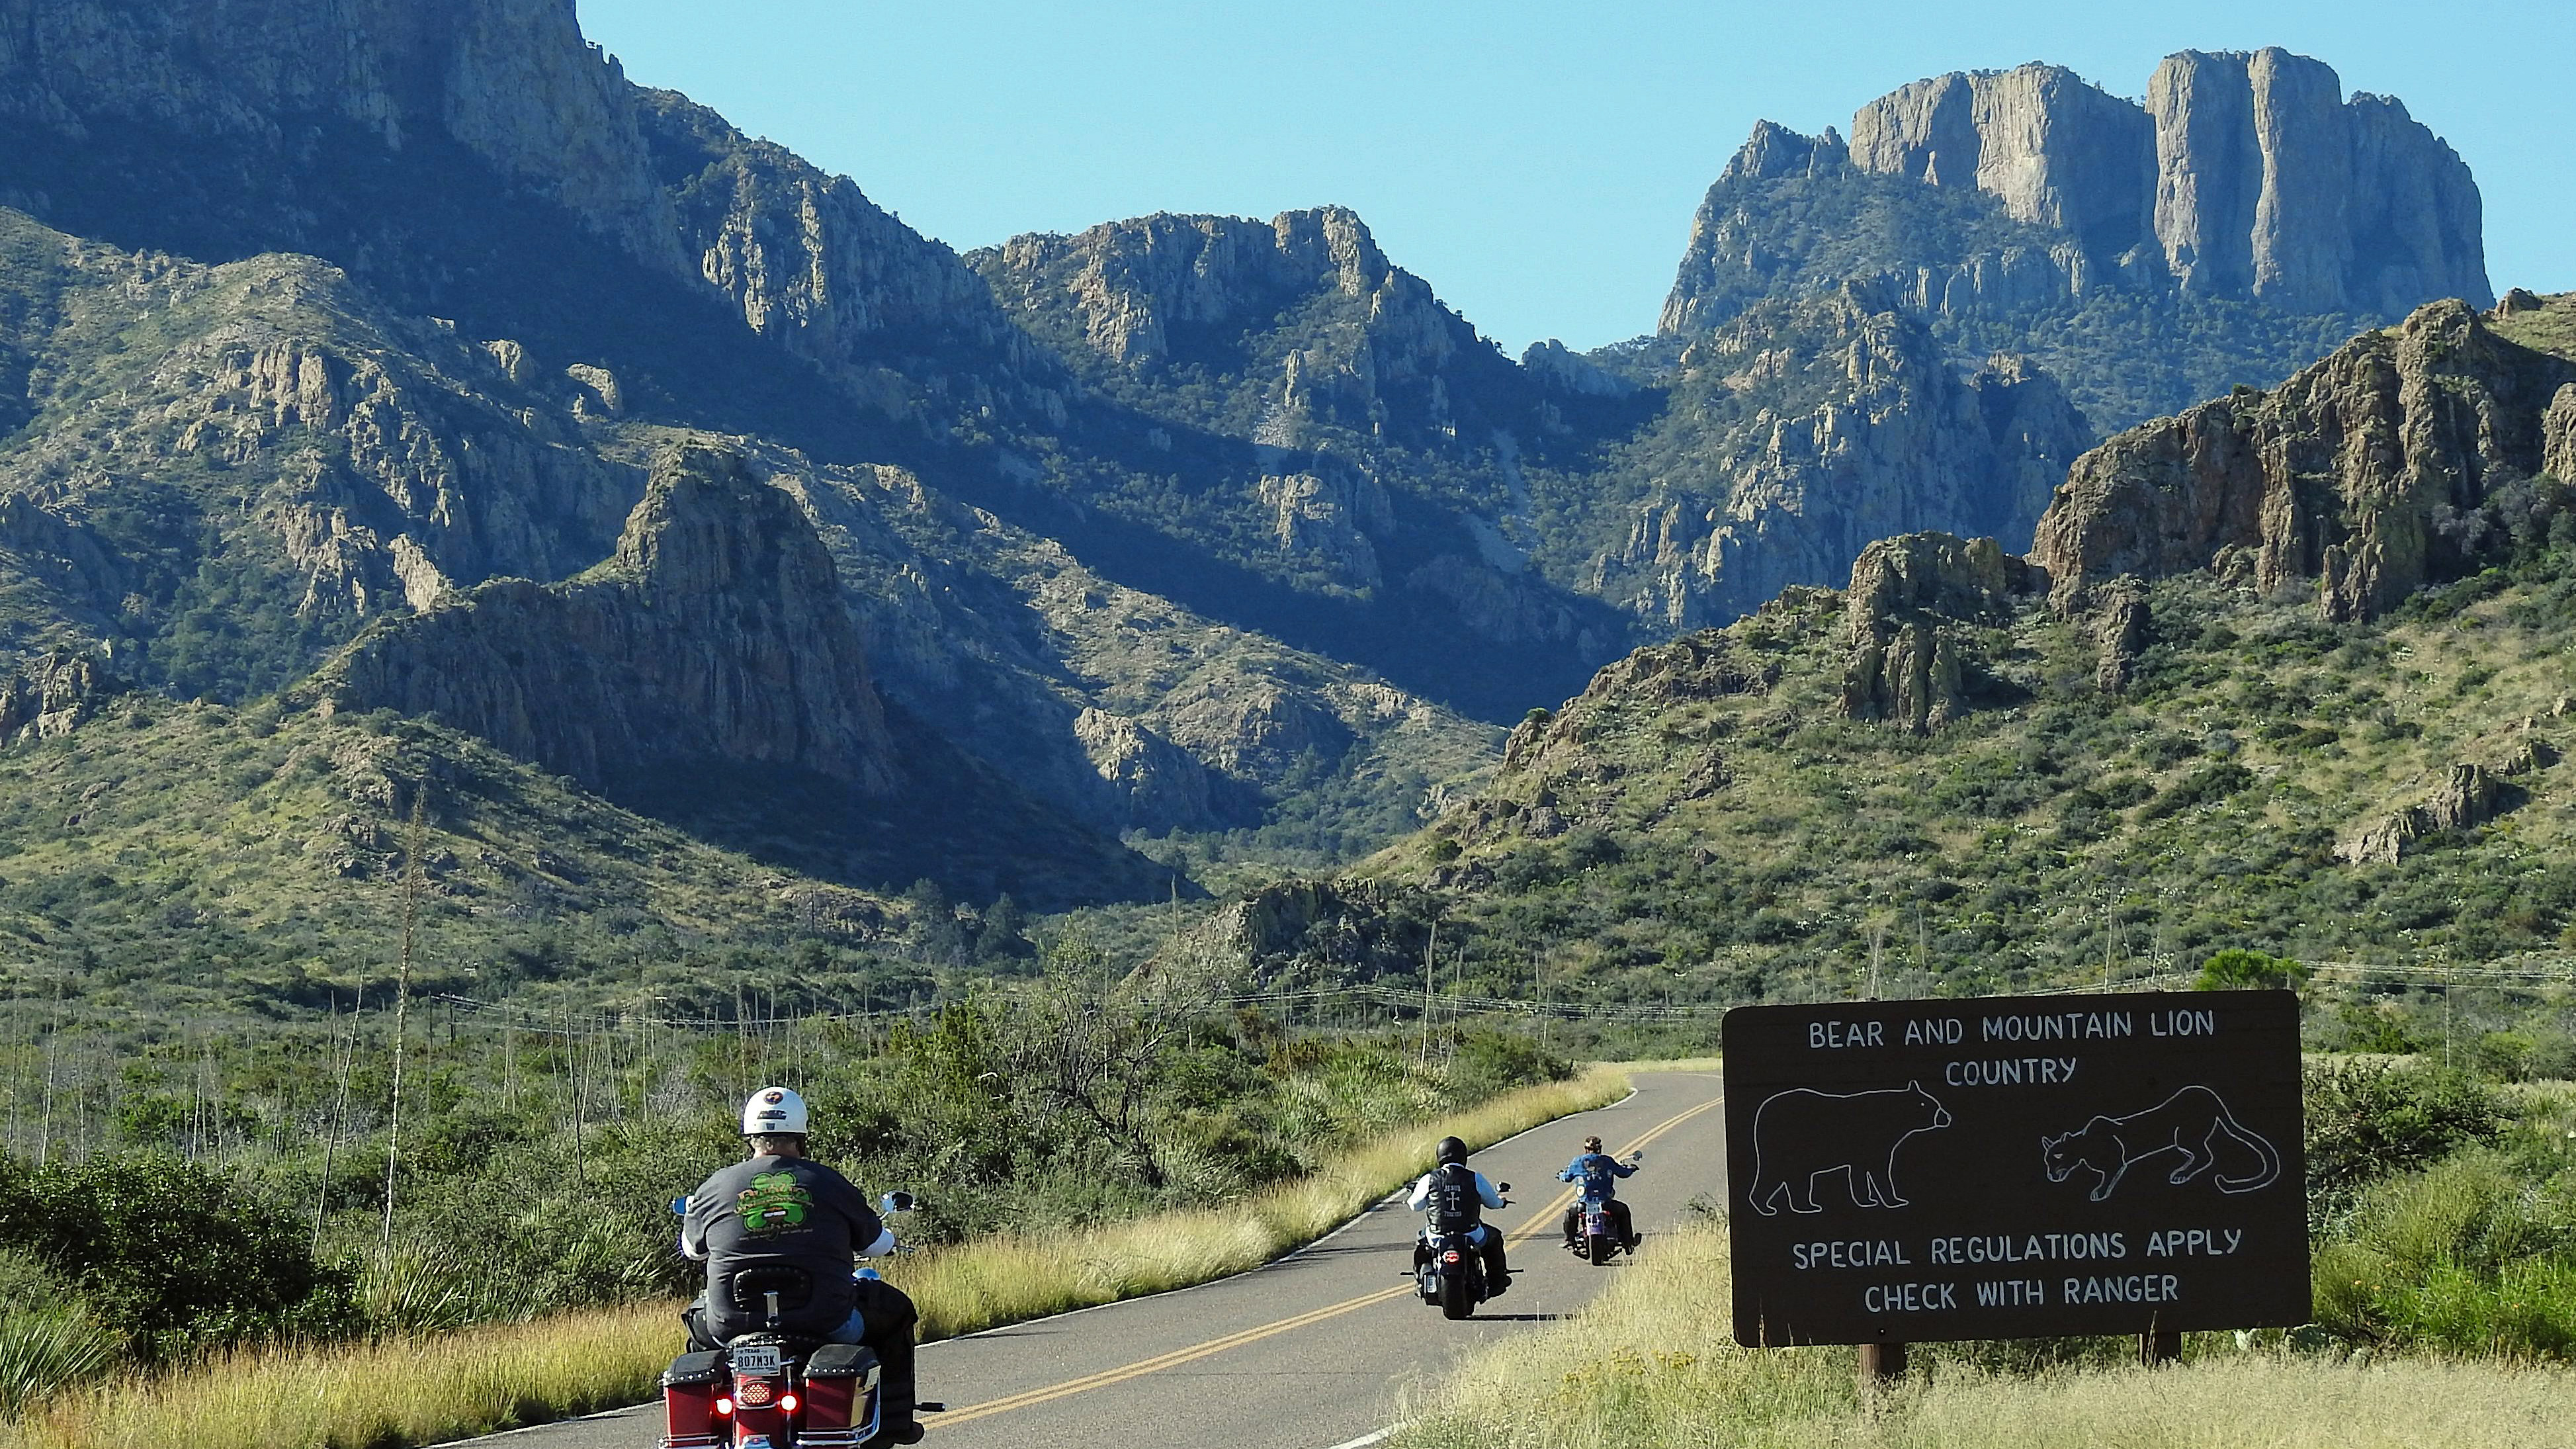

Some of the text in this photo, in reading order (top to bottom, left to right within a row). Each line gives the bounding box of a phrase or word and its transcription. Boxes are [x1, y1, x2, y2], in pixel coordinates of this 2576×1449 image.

[1809, 1009, 2213, 1048] BEAR AND MOUNTAIN LION
[1946, 1057, 2077, 1086] COUNTRY
[1793, 1229, 2241, 1270] SPECIAL REGULATIONS APPLY
[1865, 1274, 2178, 1313] CHECK WITH RANGER
